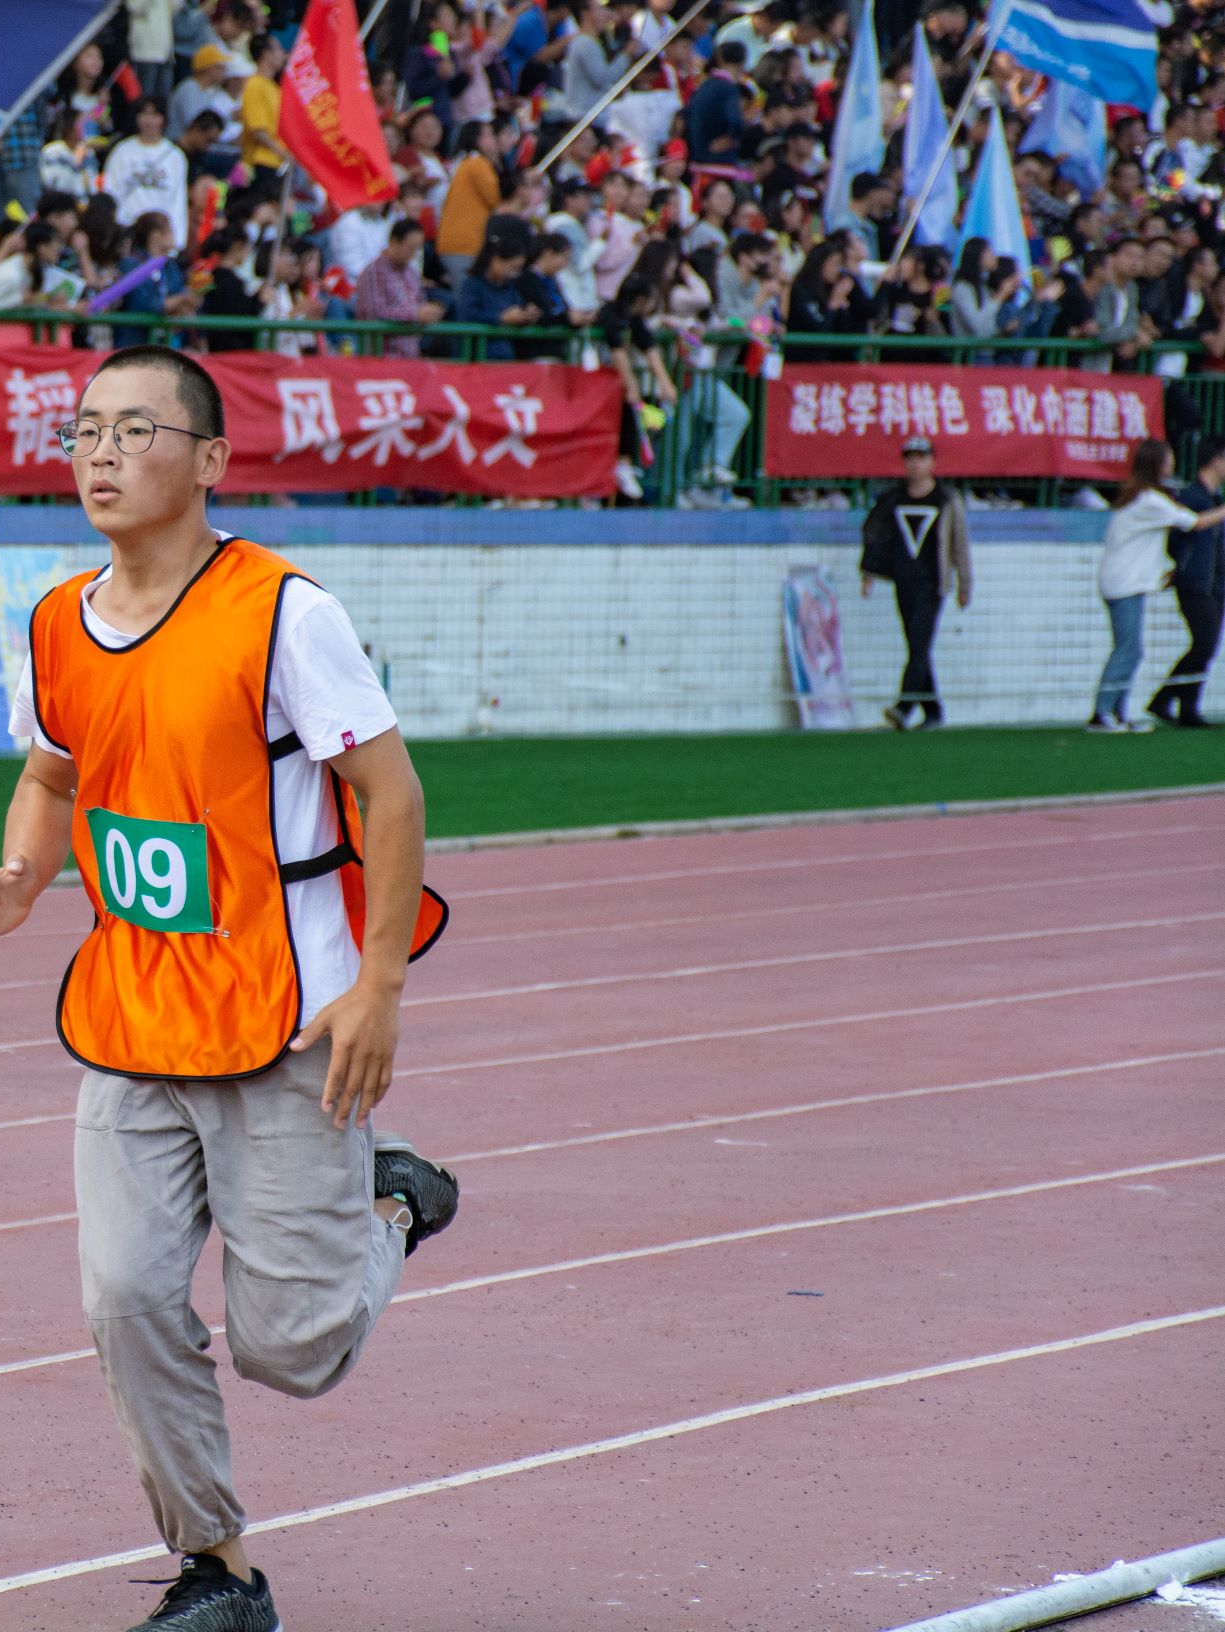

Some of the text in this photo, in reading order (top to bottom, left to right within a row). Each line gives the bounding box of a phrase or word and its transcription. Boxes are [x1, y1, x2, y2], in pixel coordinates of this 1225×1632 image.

[789, 382, 1150, 440] 凝练学科特色 深化内涵建设
[105, 828, 188, 920] 09
